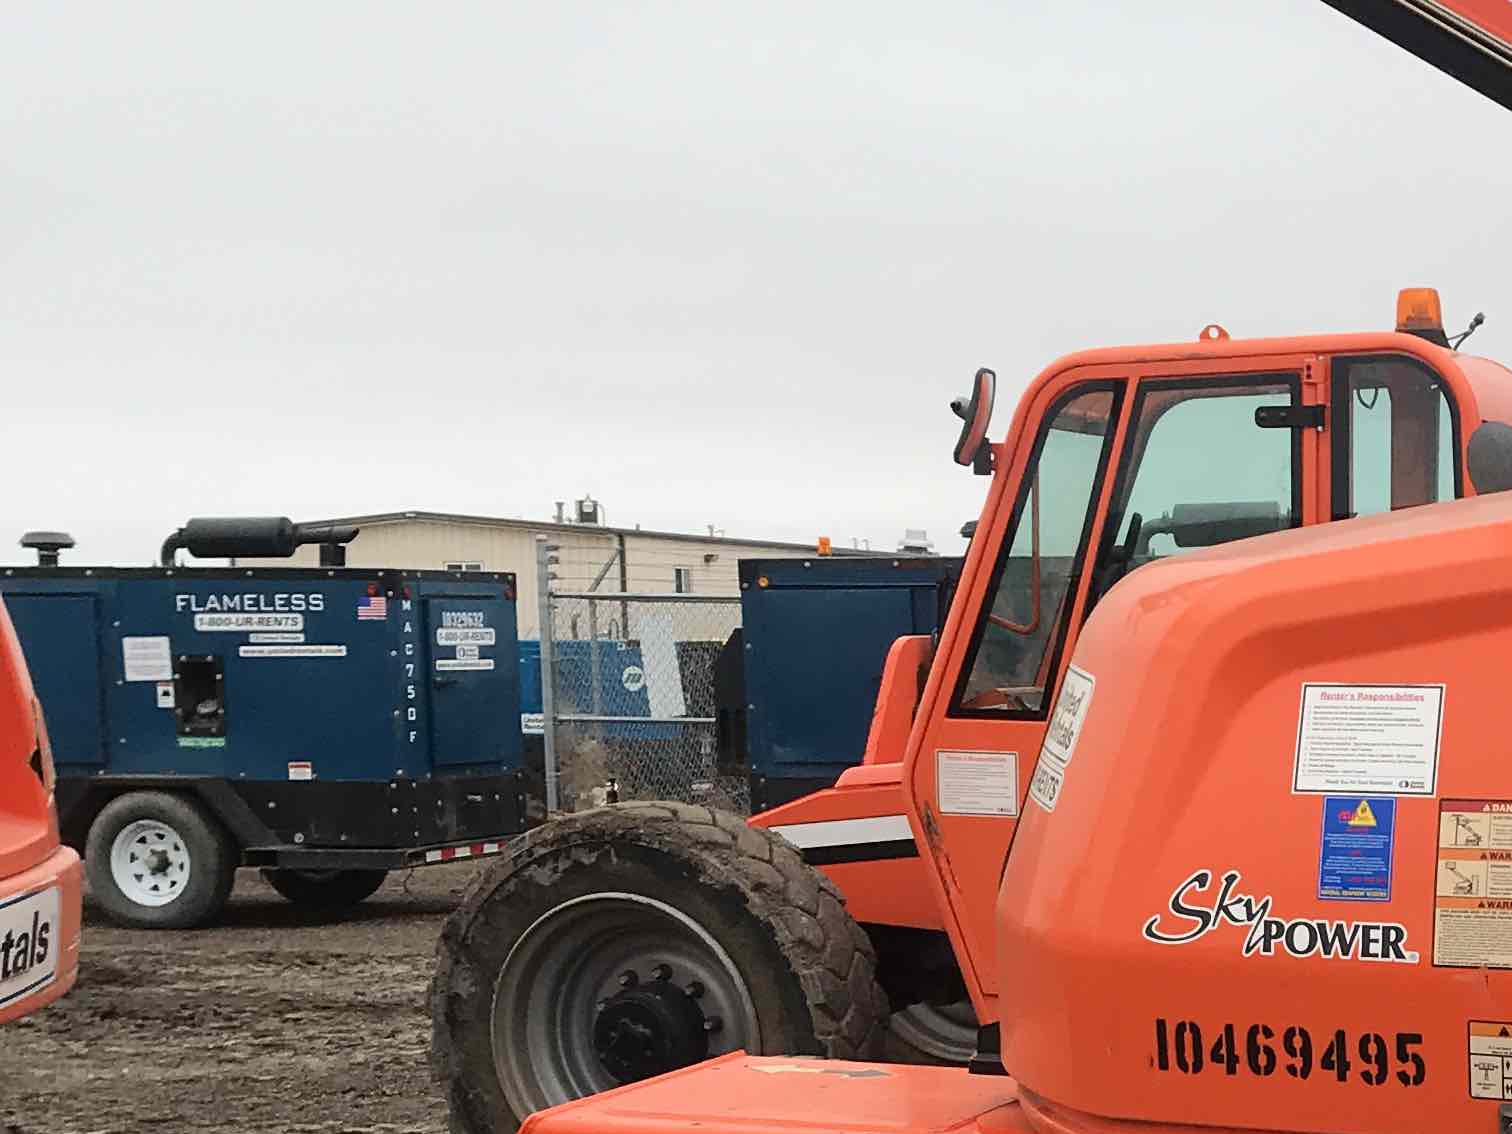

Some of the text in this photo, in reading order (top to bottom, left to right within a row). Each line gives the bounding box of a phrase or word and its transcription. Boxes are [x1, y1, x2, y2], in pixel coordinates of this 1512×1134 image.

[176, 594, 325, 611] FLAMELESS
[199, 616, 299, 627] 1-800-UR-RENTS
[1144, 871, 1271, 955] Sky
[1261, 920, 1407, 960] POWER
[1155, 1018, 1426, 1087] 10469495
